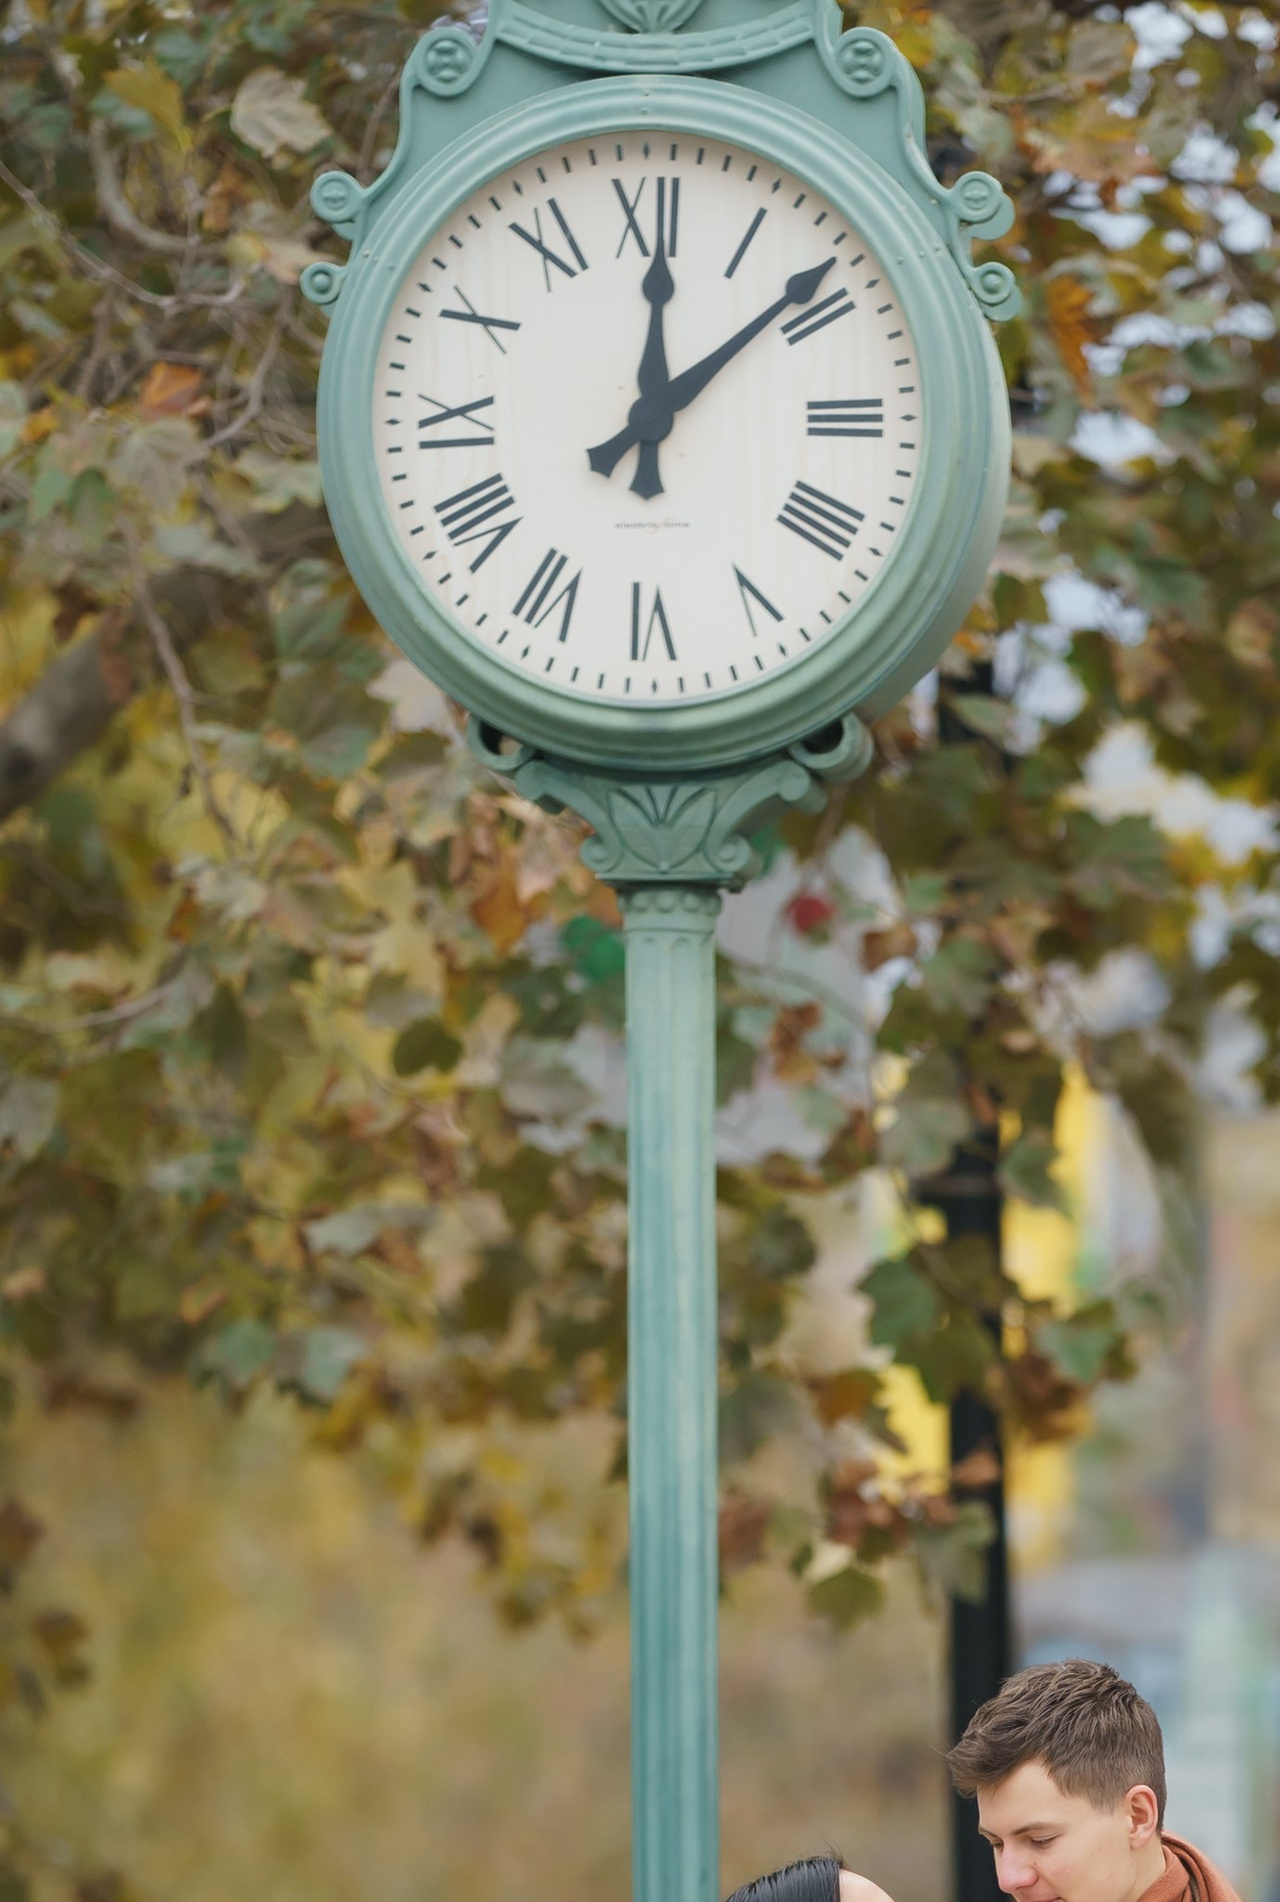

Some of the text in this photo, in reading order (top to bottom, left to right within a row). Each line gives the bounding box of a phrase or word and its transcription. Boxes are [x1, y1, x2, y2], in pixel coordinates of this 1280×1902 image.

[508, 197, 589, 293] XI
[611, 175, 681, 259] XII
[724, 206, 768, 279] I
[438, 284, 522, 354] X
[779, 286, 857, 346] II
[417, 393, 495, 450] IX
[806, 398, 884, 438] III
[432, 472, 524, 575] VIII
[776, 479, 865, 562] IIII
[512, 547, 583, 643] VII
[629, 582, 678, 661] VI
[732, 561, 784, 637] V
